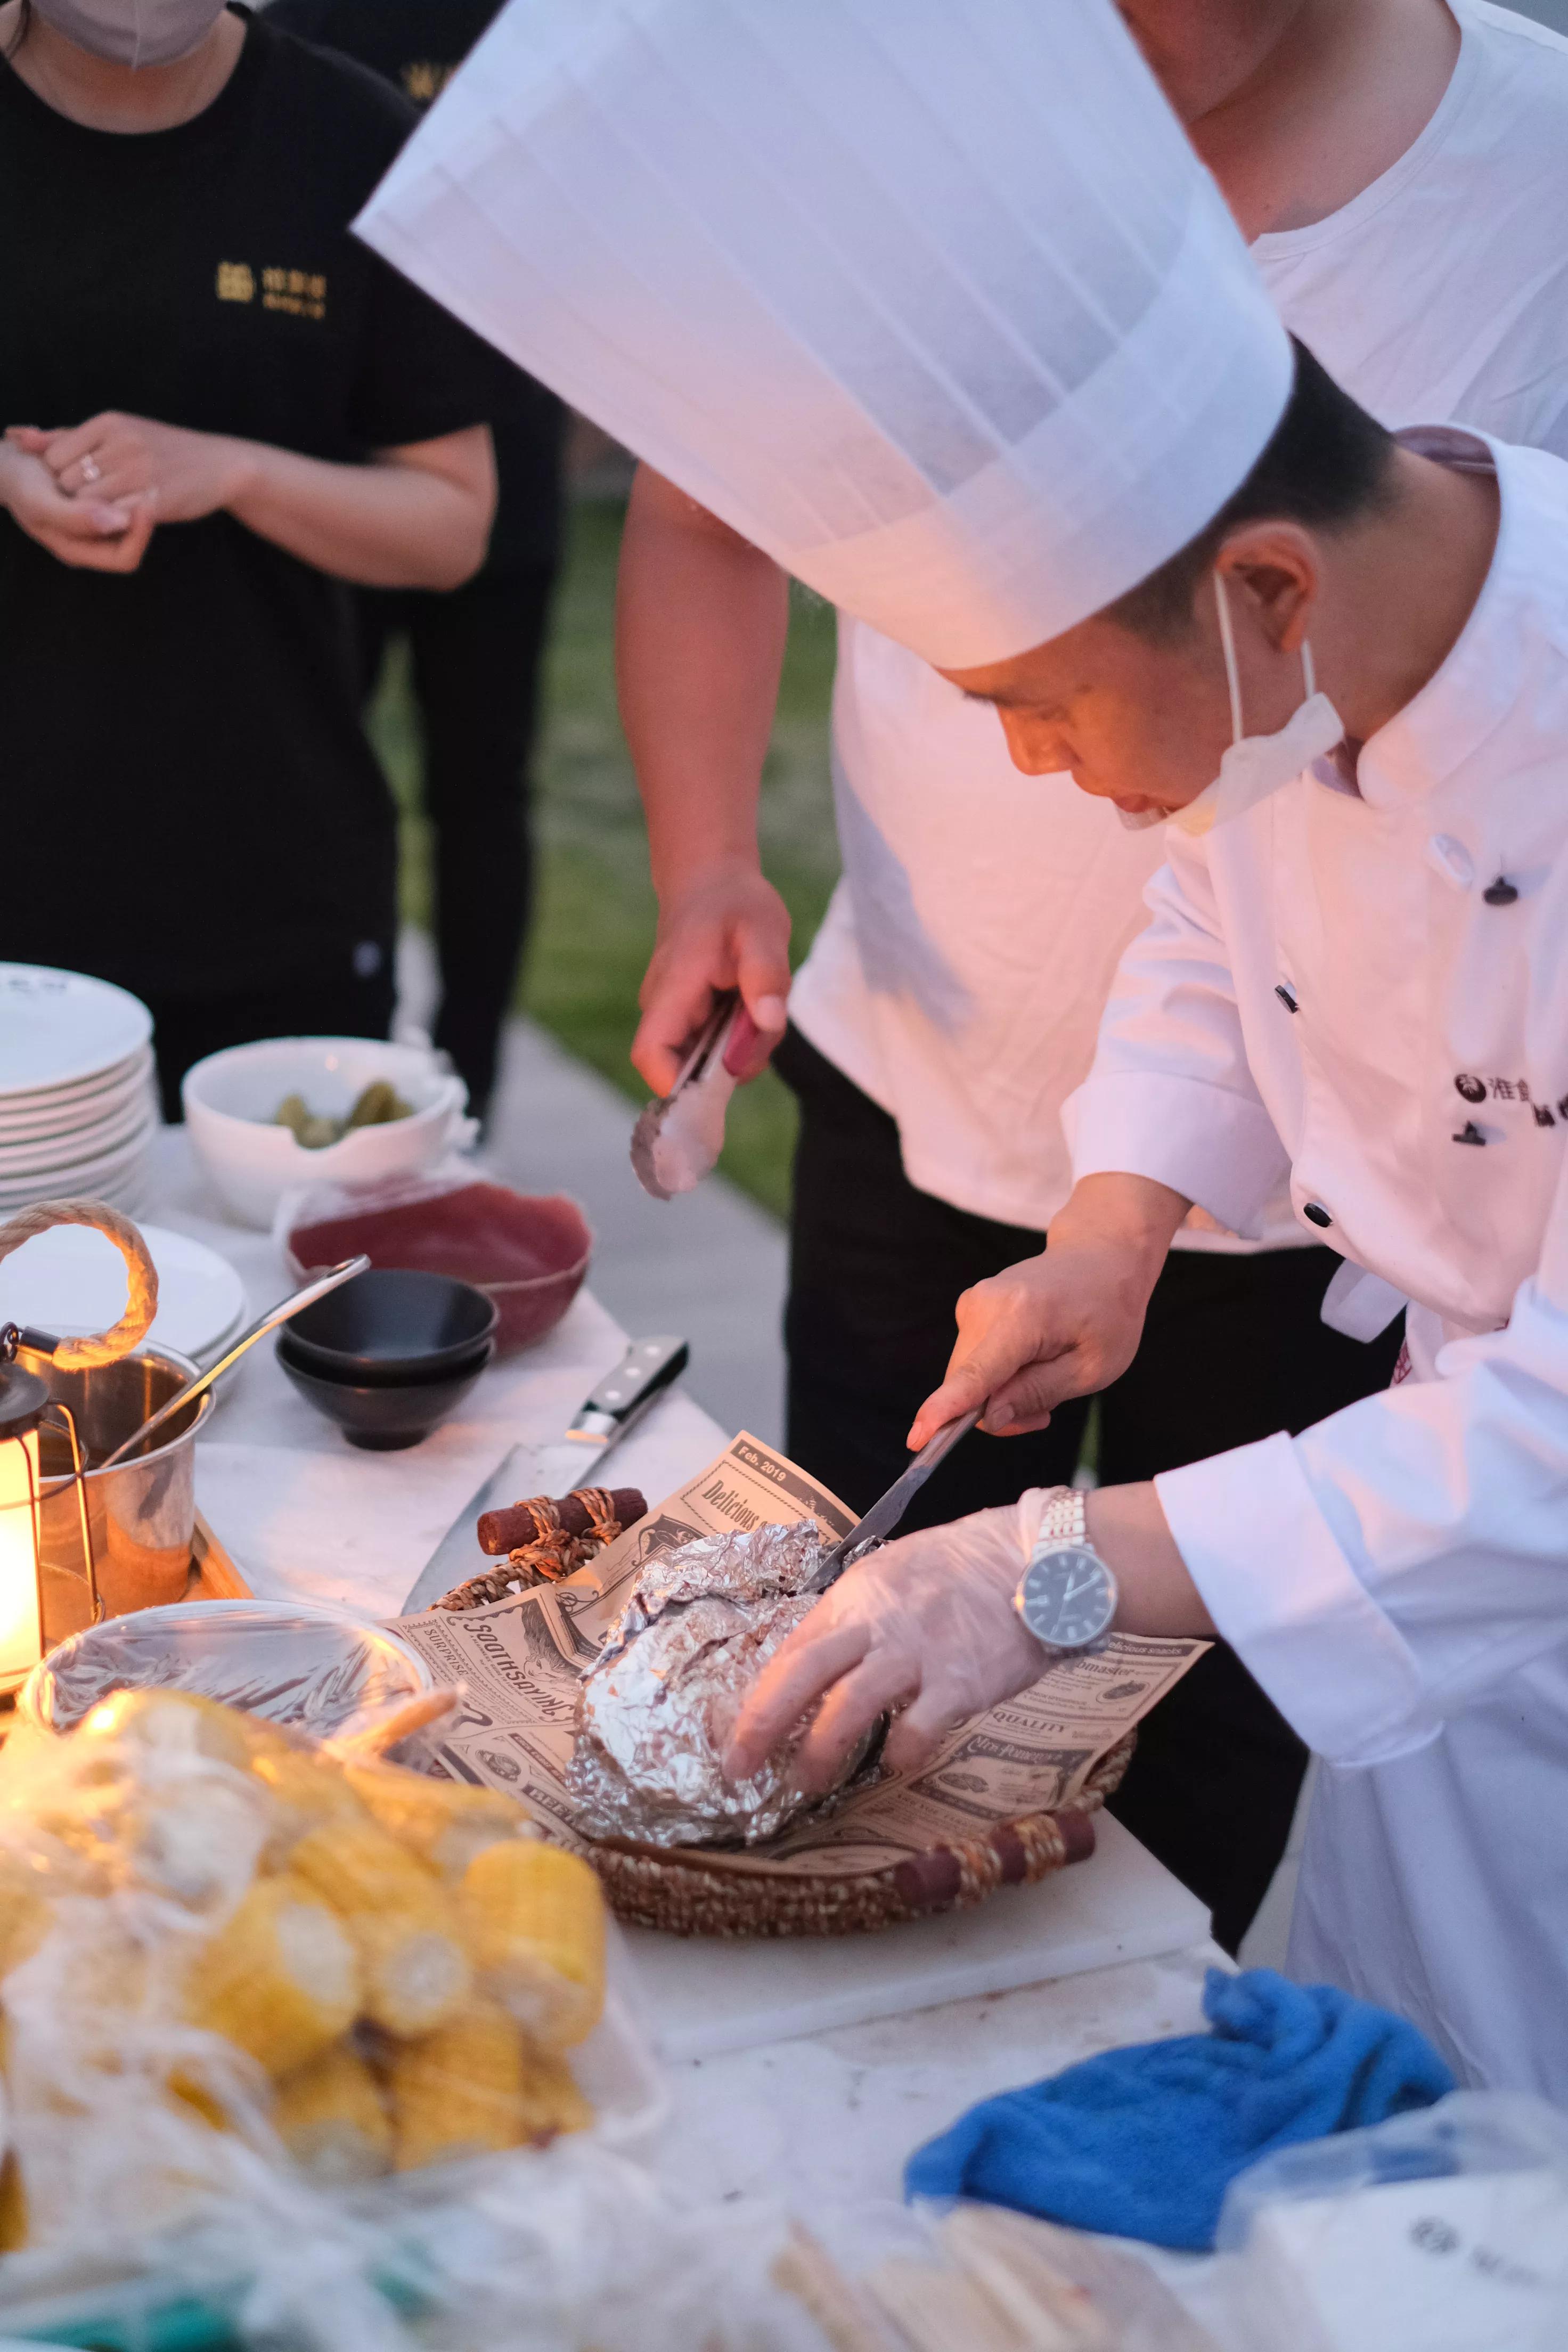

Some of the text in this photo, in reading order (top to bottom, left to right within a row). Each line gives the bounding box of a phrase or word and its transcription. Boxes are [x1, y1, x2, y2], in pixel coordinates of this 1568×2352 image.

[738, 1446, 787, 1482] Feb. 2019
[701, 1479, 760, 1531] Delicious
[424, 1628, 469, 1676] SURPRISE
[463, 1623, 575, 1717] SOOTHSAYING
[490, 1663, 502, 1676] GUIDE
[992, 1711, 1065, 1733] QUALITY
